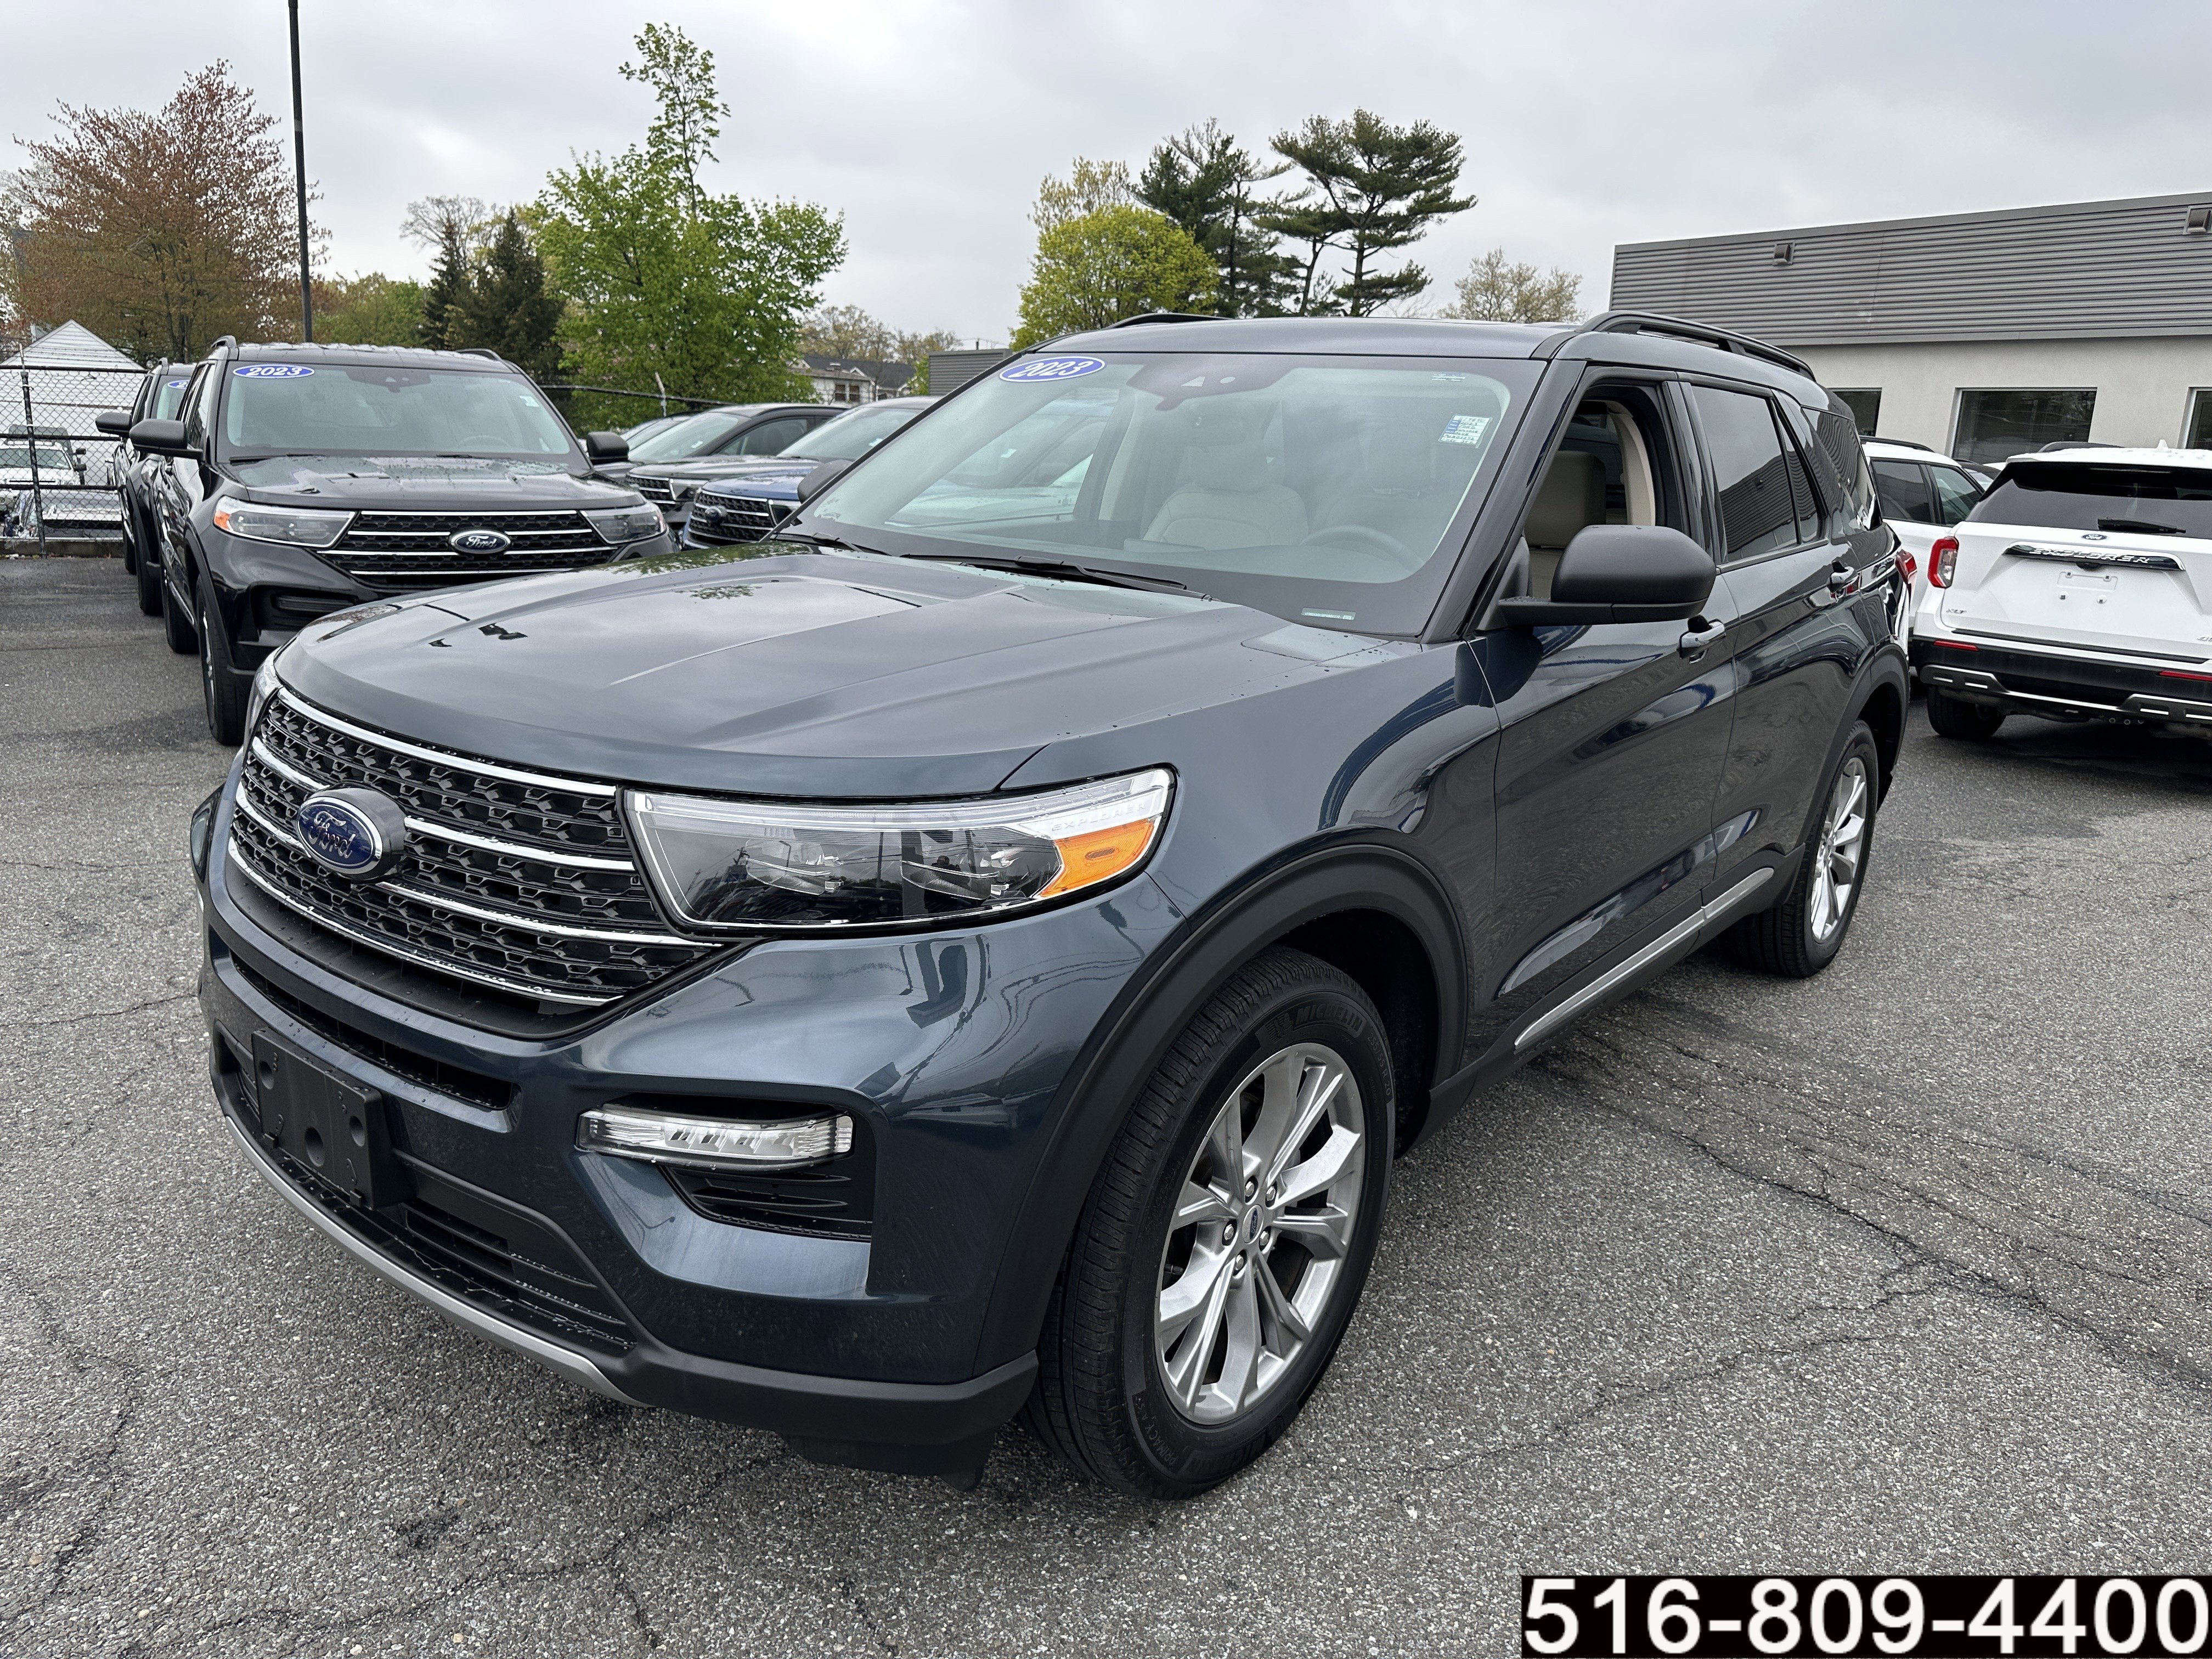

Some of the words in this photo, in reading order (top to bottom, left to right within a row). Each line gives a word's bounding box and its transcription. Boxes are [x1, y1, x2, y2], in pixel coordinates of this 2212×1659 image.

[246, 366, 302, 376] 2023
[1007, 361, 1094, 377] 2023
[466, 535, 497, 548] Ford
[2029, 548, 2150, 564] EXPLORER
[1052, 803, 1146, 832] EXPLORER
[307, 810, 357, 859] Ford
[1295, 1003, 1364, 1034] MICHELIN
[1367, 1032, 1386, 1068] 255/55
[1144, 1422, 1179, 1466] PRIMACY
